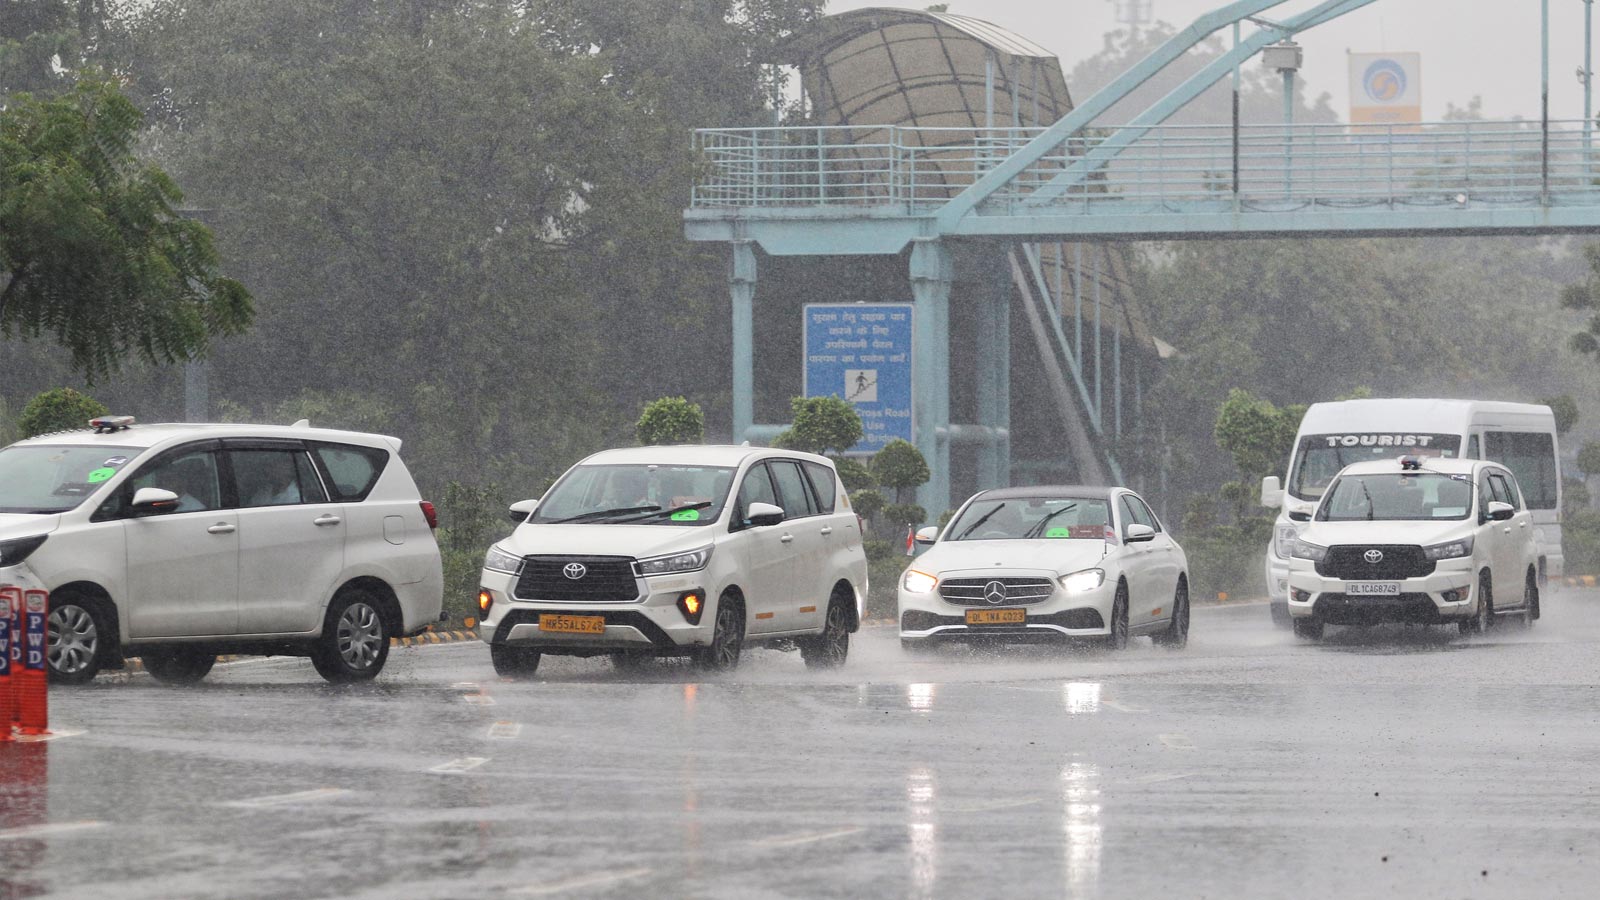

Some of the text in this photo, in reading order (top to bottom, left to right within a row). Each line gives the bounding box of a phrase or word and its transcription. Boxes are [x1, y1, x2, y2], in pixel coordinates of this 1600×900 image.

[890, 313, 905, 321] पार
[857, 326, 868, 334] के
[872, 325, 889, 335] लिए
[842, 354, 854, 362] का
[885, 408, 910, 417] Road
[867, 422, 886, 430] Use
[1326, 435, 1433, 447] TOURIST
[28, 615, 43, 664] PWD
